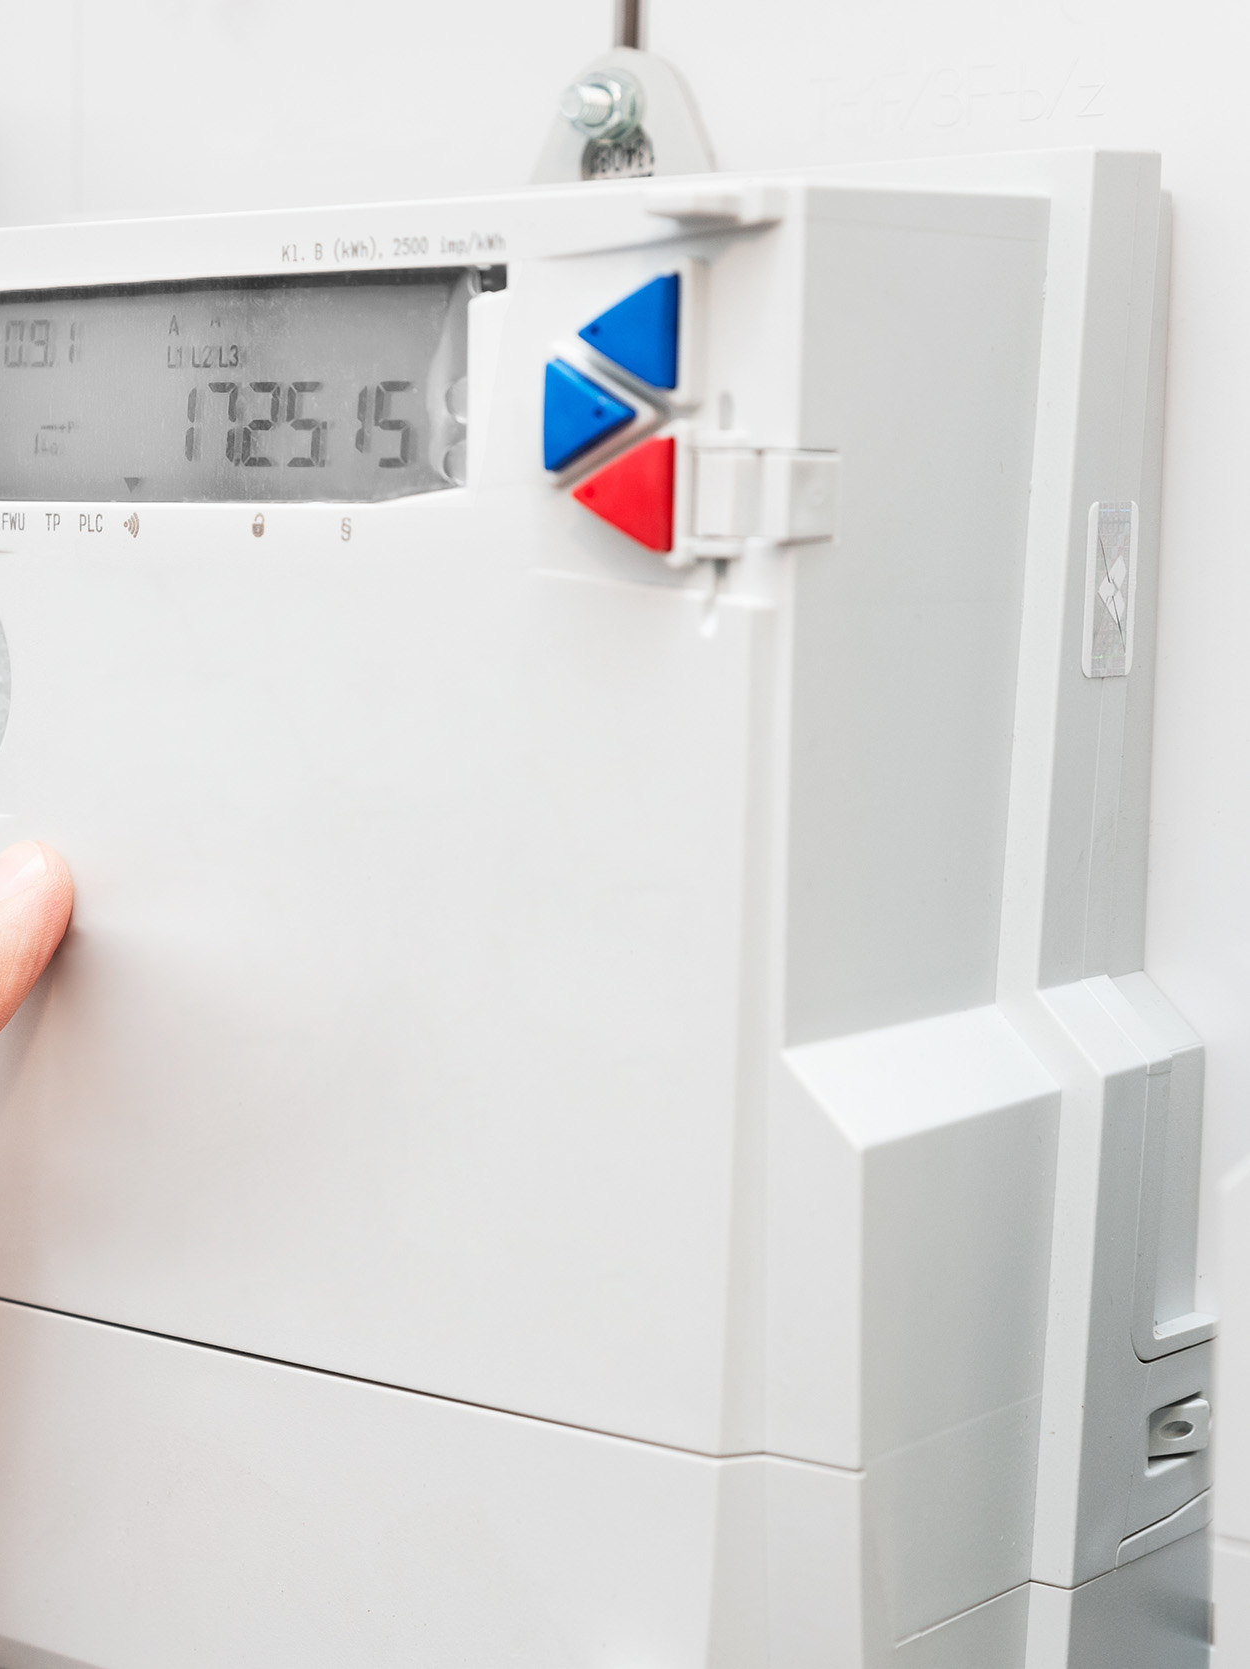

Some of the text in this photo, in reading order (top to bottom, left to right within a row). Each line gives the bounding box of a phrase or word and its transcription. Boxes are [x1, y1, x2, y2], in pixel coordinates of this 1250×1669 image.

[314, 242, 324, 261] B
[392, 236, 429, 257] 2500
[168, 314, 180, 336] A
[218, 345, 240, 368] L3
[1, 512, 26, 532] FWU
[45, 512, 62, 532] TP
[78, 513, 104, 533] PLC
